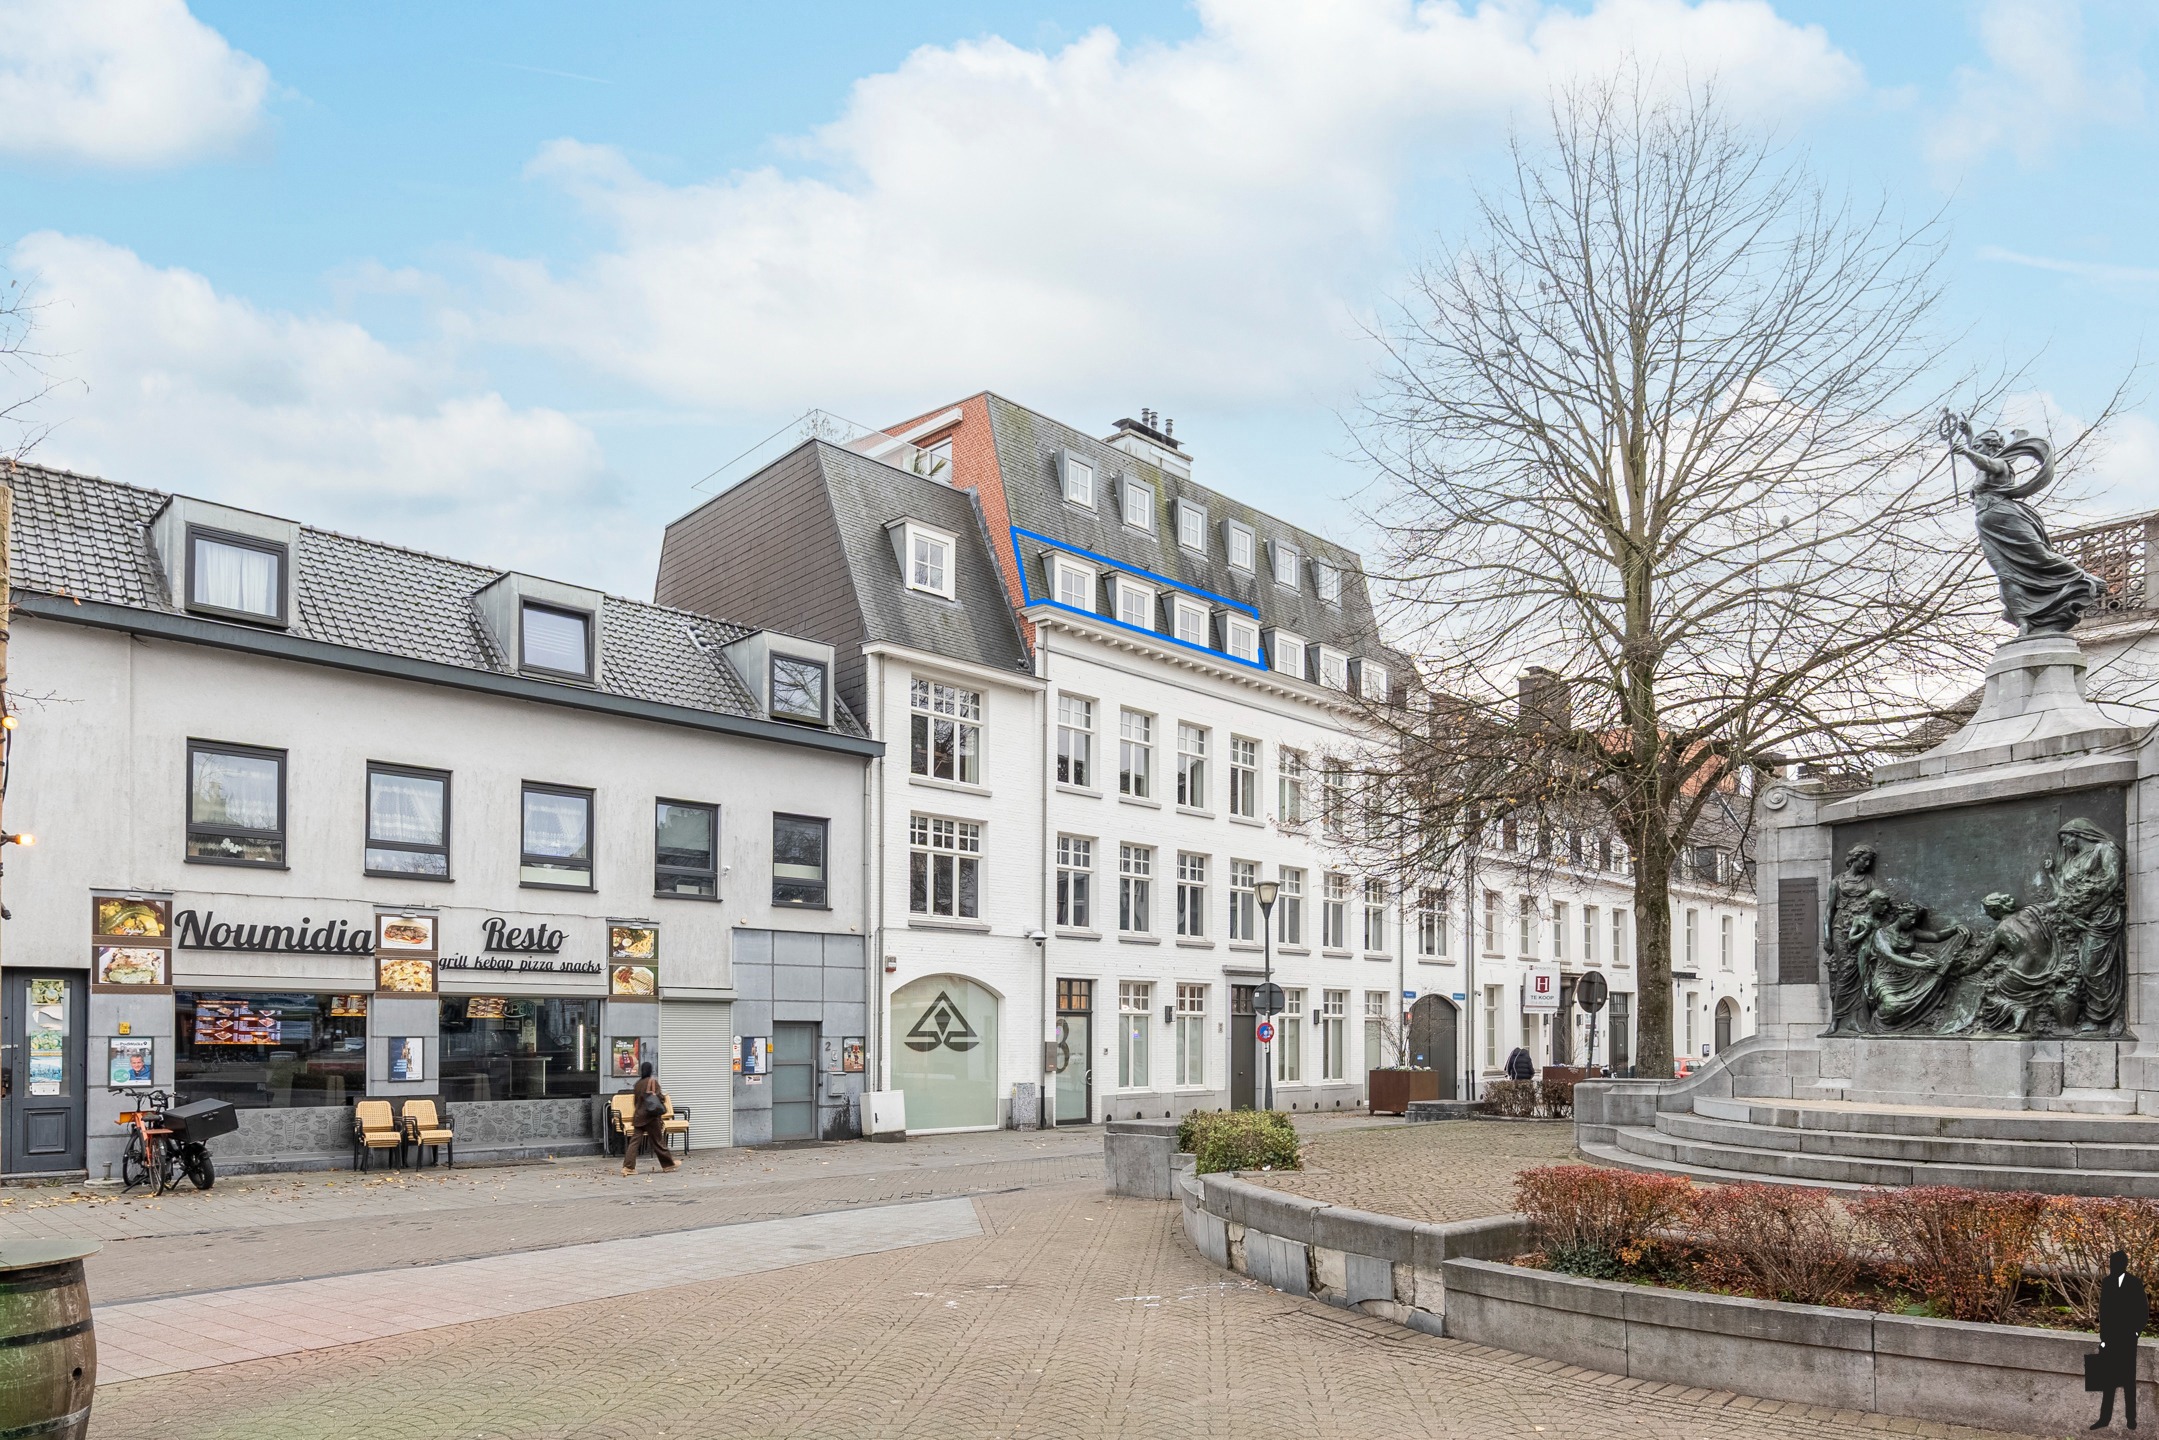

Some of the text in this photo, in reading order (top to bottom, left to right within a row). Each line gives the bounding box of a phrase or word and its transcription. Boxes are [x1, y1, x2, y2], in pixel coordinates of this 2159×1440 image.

[174, 910, 376, 955] Noumidia
[482, 917, 569, 953] Resto
[439, 952, 602, 973] grill kebap pizza snacks
[825, 1041, 831, 1051] 2
